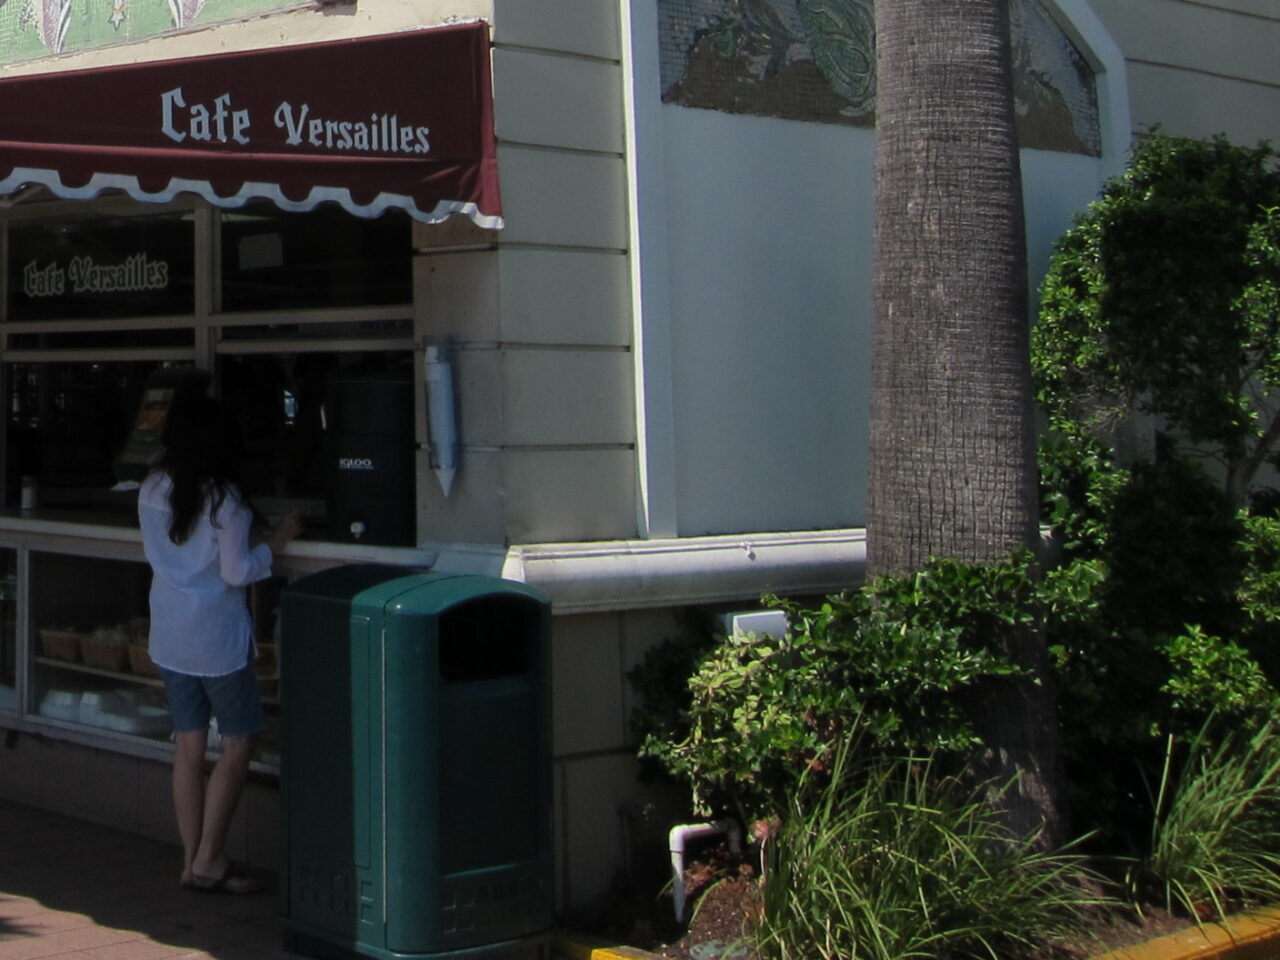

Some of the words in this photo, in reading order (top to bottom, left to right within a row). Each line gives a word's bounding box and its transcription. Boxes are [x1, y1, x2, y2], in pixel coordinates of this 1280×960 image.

[160, 86, 252, 145] Cafe
[273, 100, 431, 154] Versailles
[23, 259, 65, 298] Cafe
[69, 251, 169, 294] Versailles
